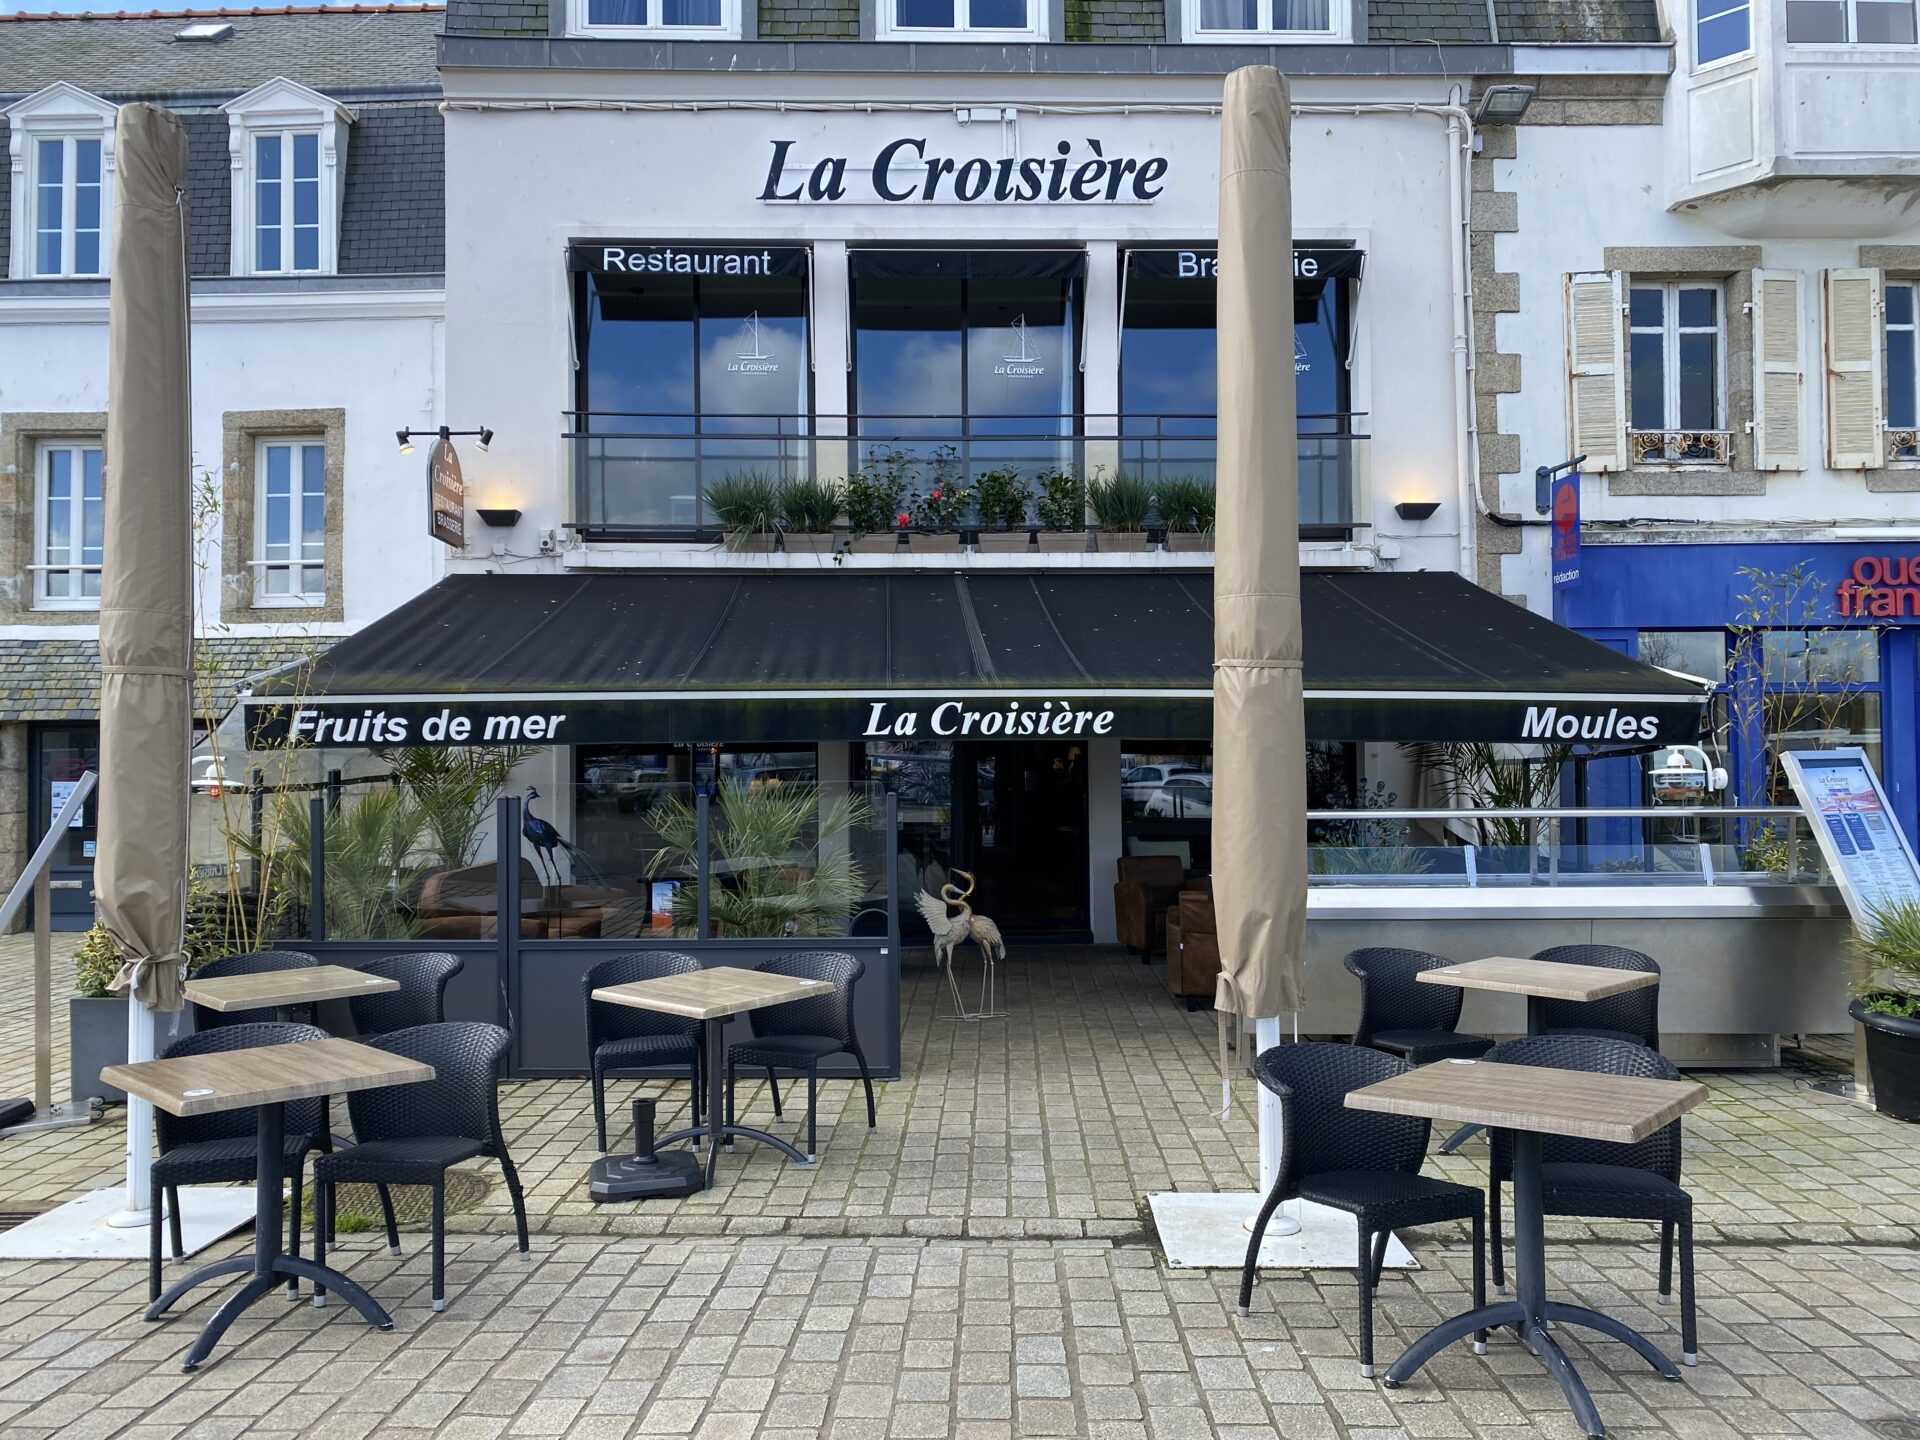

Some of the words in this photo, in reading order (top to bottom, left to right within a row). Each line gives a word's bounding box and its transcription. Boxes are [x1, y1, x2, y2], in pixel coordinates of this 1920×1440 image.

[755, 140, 846, 202] La
[873, 138, 1168, 202] Croisière
[603, 247, 772, 275] Restaurant
[728, 363, 738, 371] La
[994, 365, 1005, 374] La
[1006, 364, 1045, 375] Croisière
[443, 443, 453, 464] La
[1553, 569, 1580, 584] rédaction
[290, 709, 409, 742] Fruits
[421, 708, 471, 742] de
[483, 714, 567, 741] mer
[863, 702, 918, 736] La
[930, 700, 1115, 736] Croisière
[1521, 706, 1659, 740] Moules
